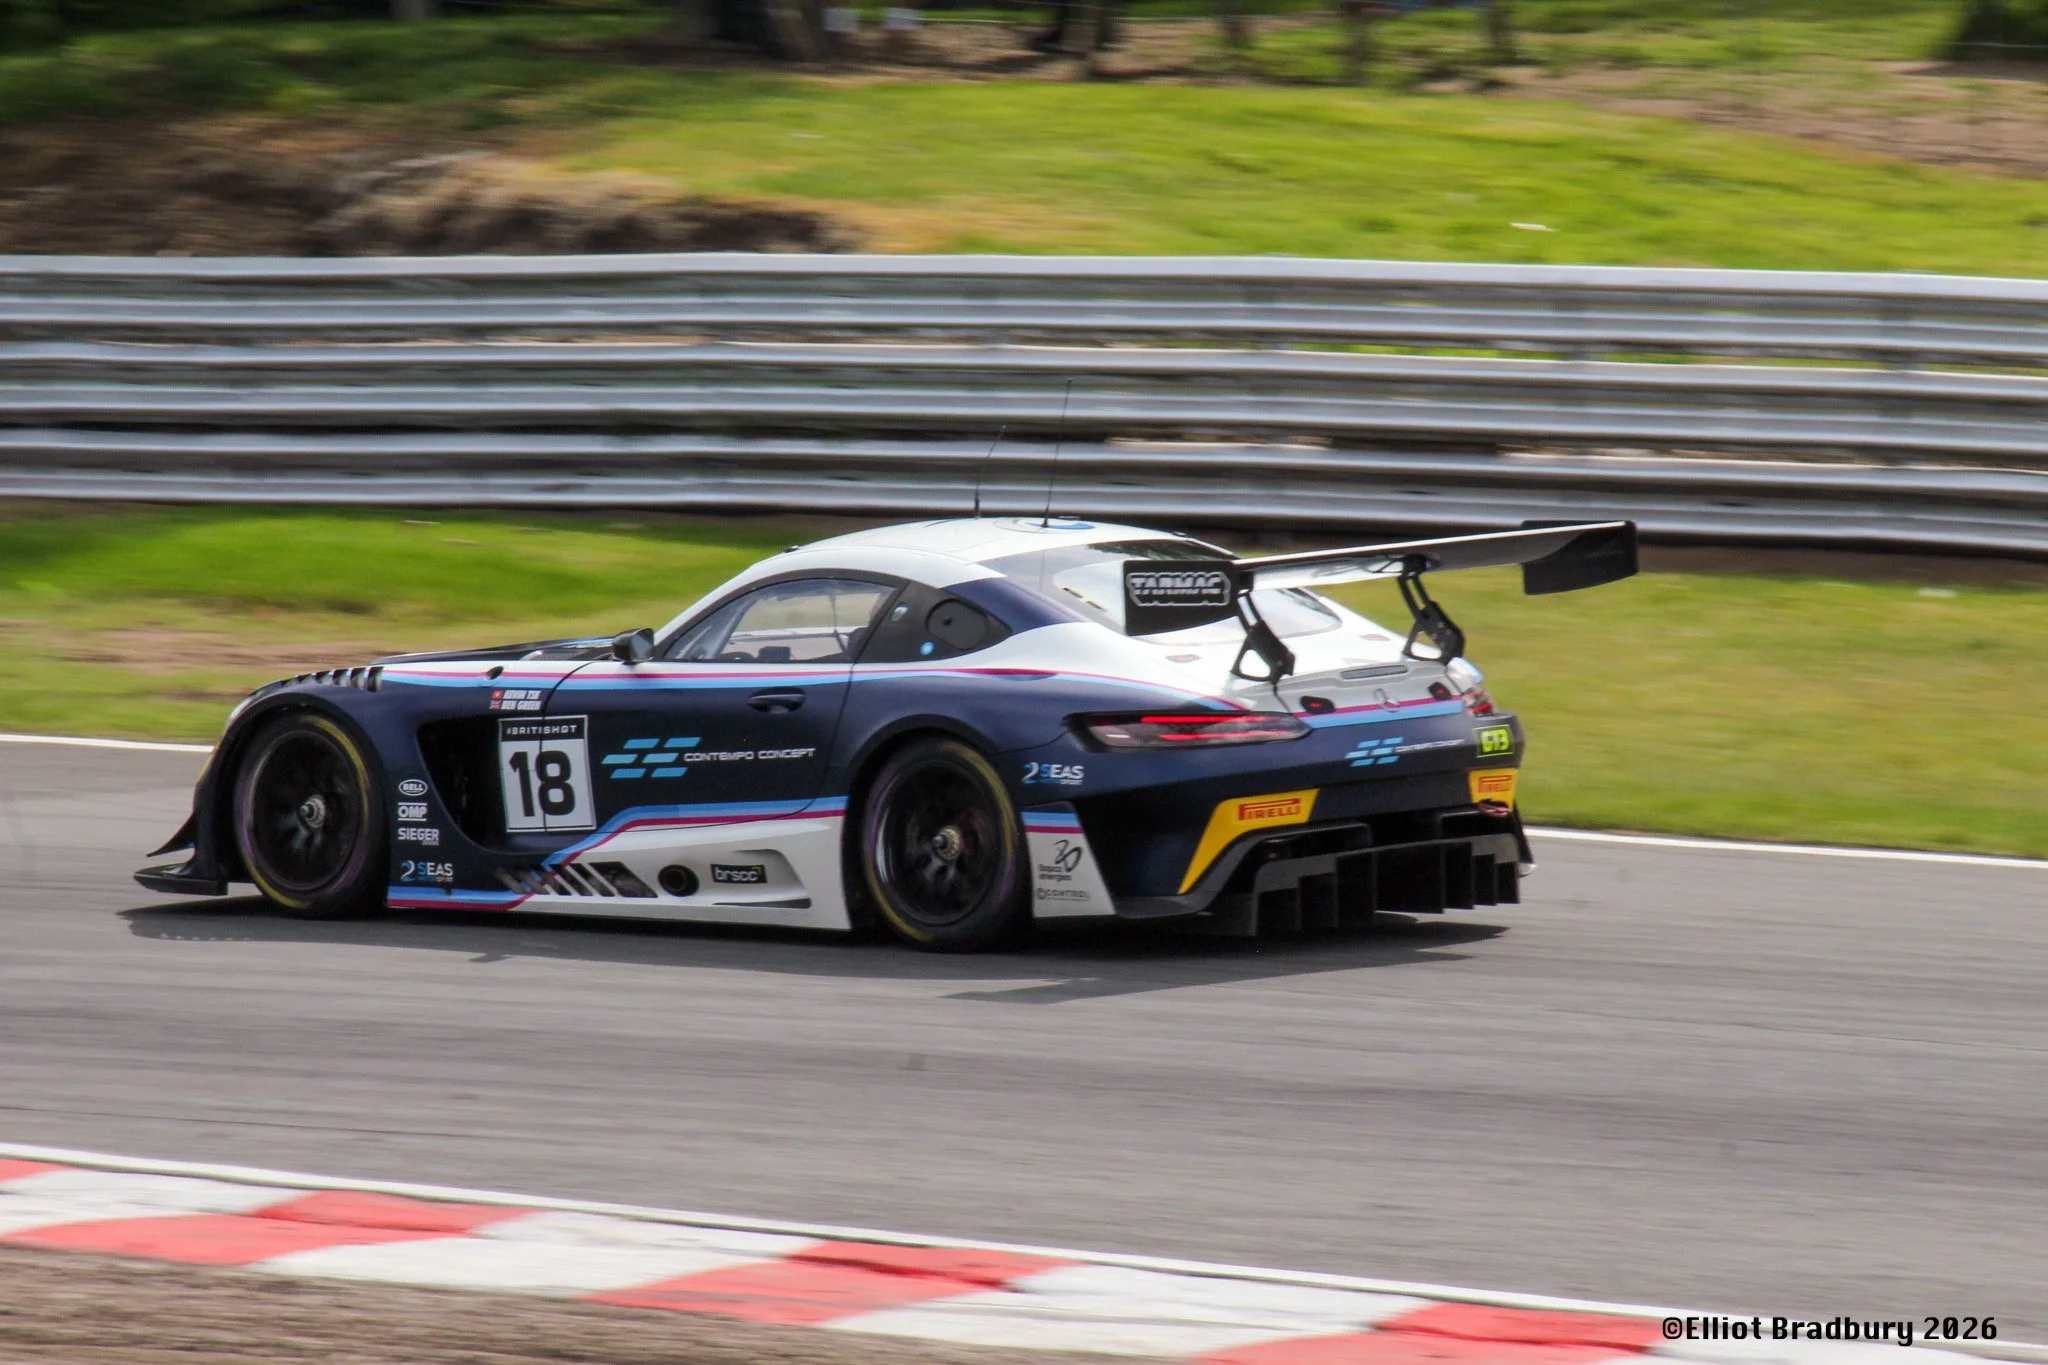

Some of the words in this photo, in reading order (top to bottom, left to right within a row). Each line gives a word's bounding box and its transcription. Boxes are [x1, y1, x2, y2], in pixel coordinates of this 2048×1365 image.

[683, 751, 754, 762] CONTEMPO
[757, 748, 816, 759] CONCEPT
[1040, 763, 1084, 779] SEAS
[402, 783, 424, 791] BELL
[509, 750, 576, 817] 18
[1478, 775, 1513, 793] PIRELLI
[398, 805, 427, 818] OMP
[1238, 798, 1301, 821] PIRELLI
[398, 827, 440, 841] SIEGER
[417, 861, 453, 876] SEAS
[714, 867, 758, 882] brscc
